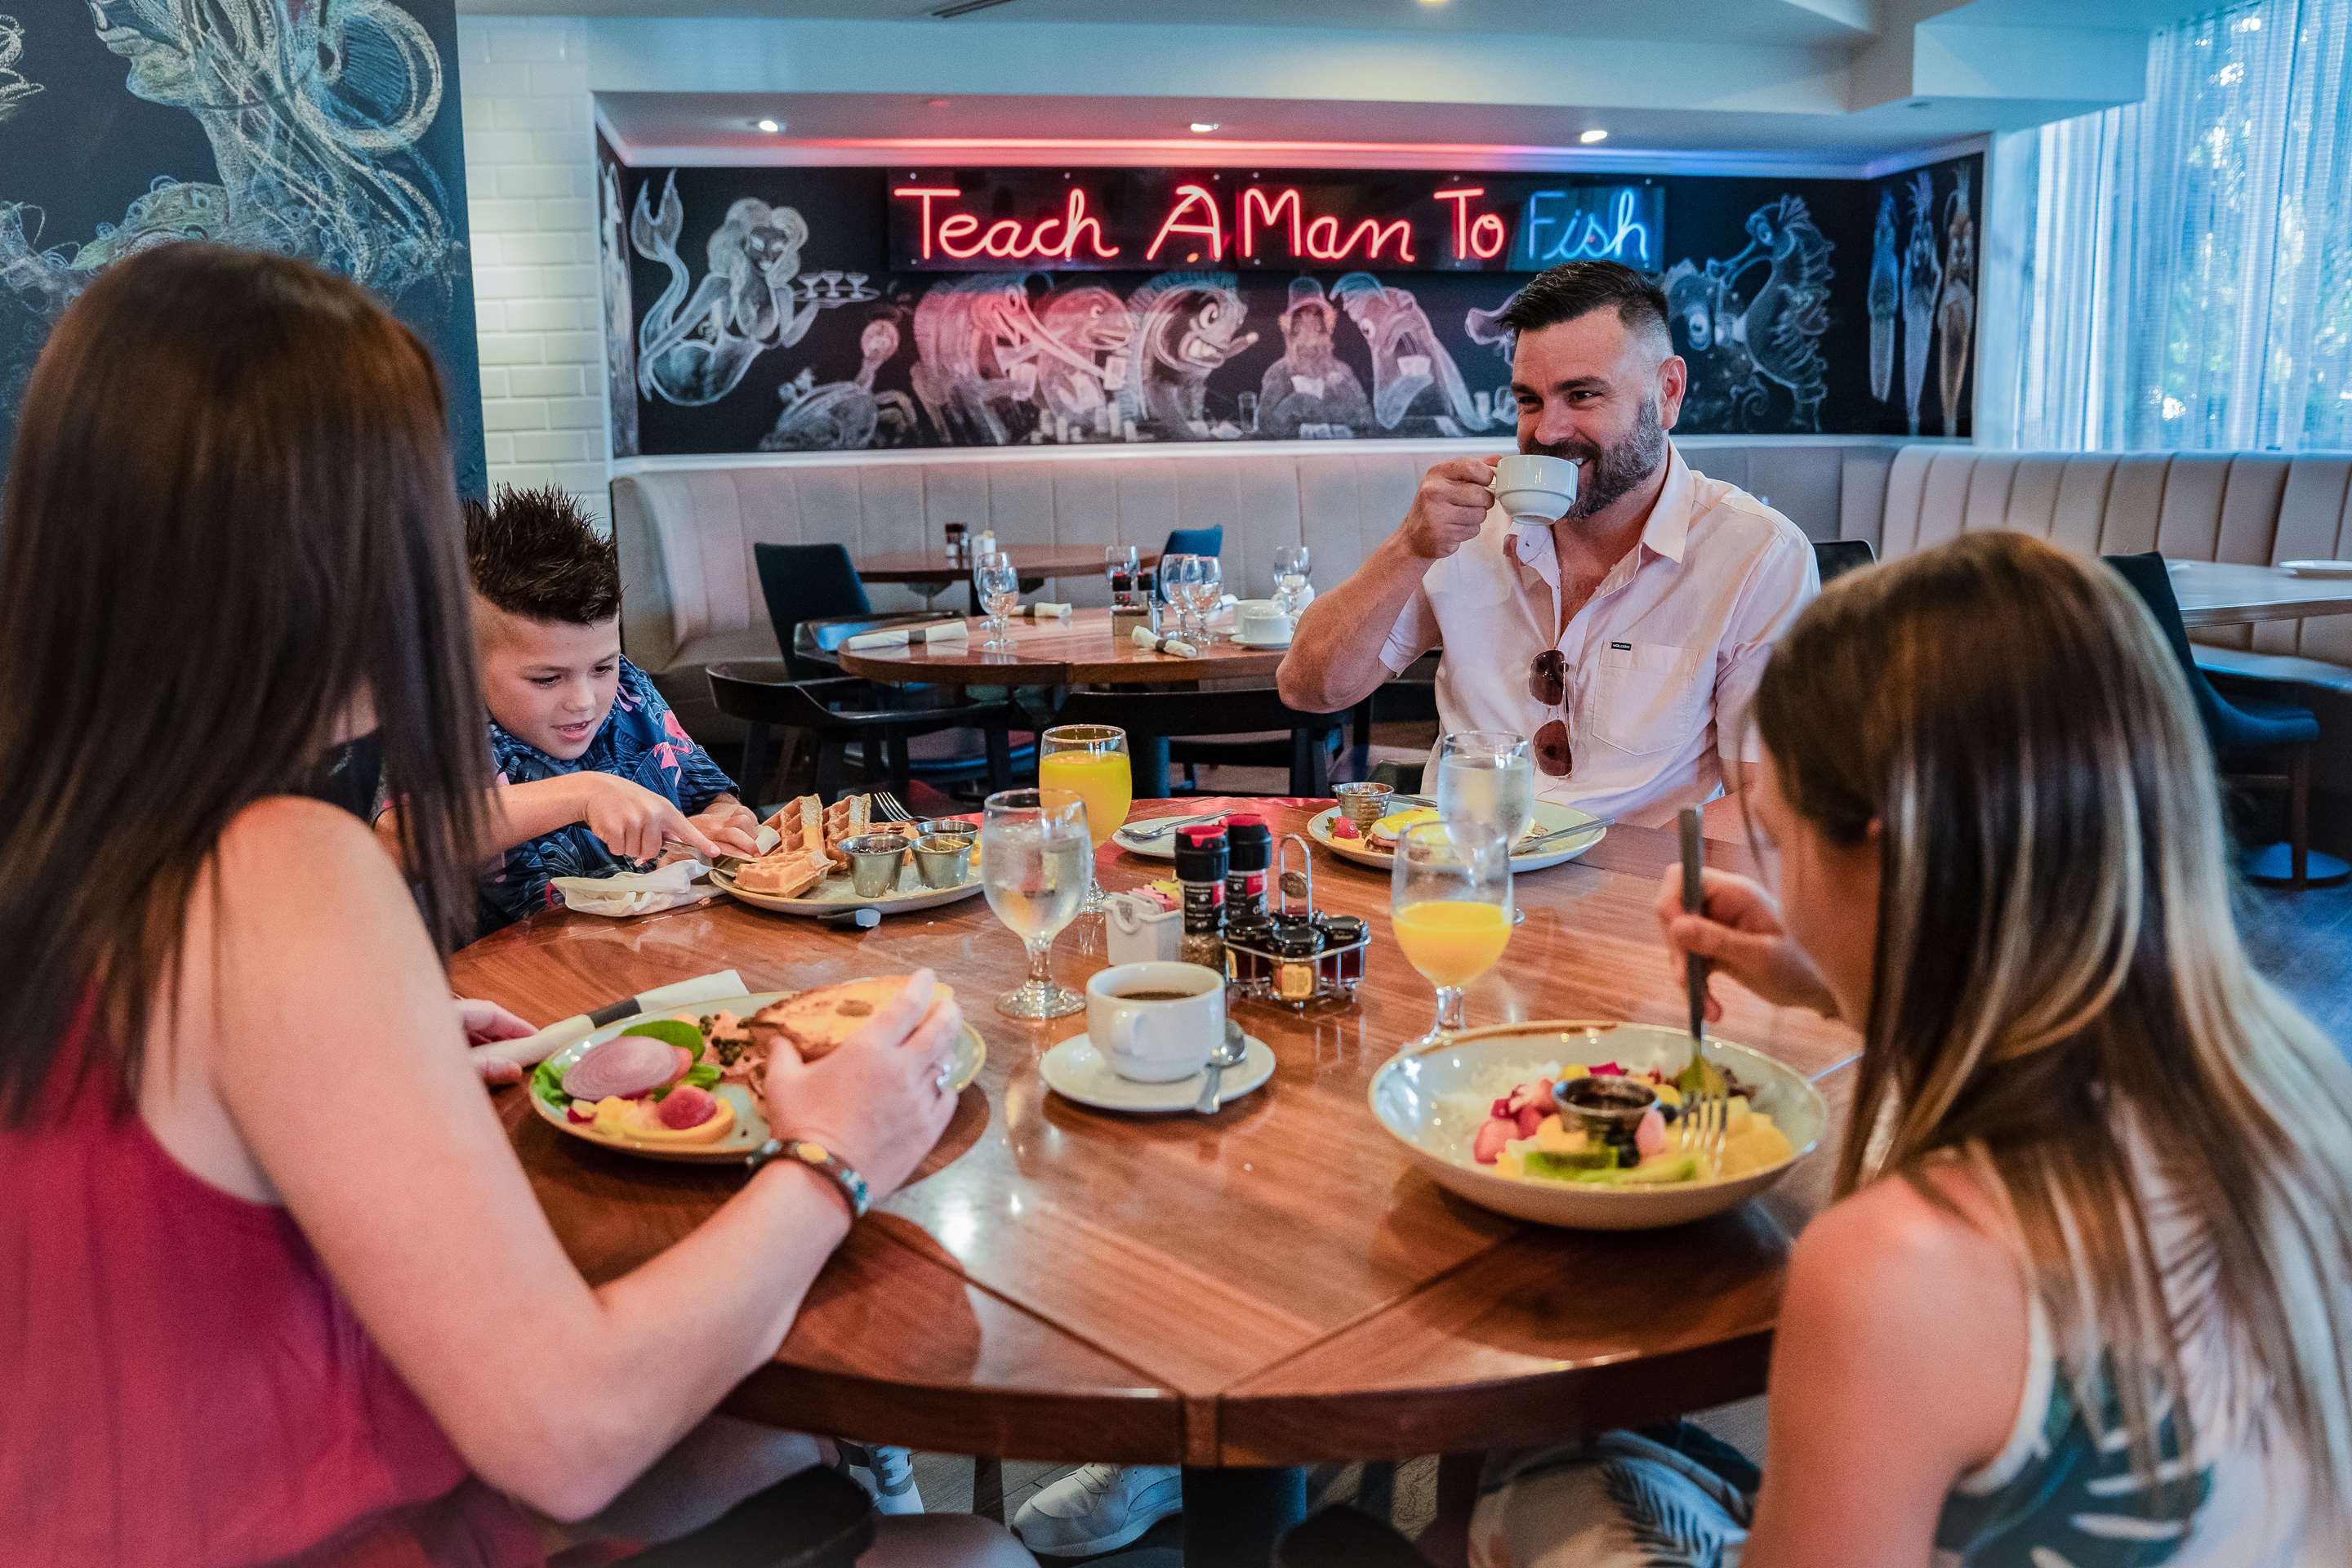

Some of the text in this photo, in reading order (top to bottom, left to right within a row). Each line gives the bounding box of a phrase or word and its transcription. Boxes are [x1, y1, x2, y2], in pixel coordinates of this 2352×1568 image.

[893, 185, 1648, 262] Teach A Man To Fish
